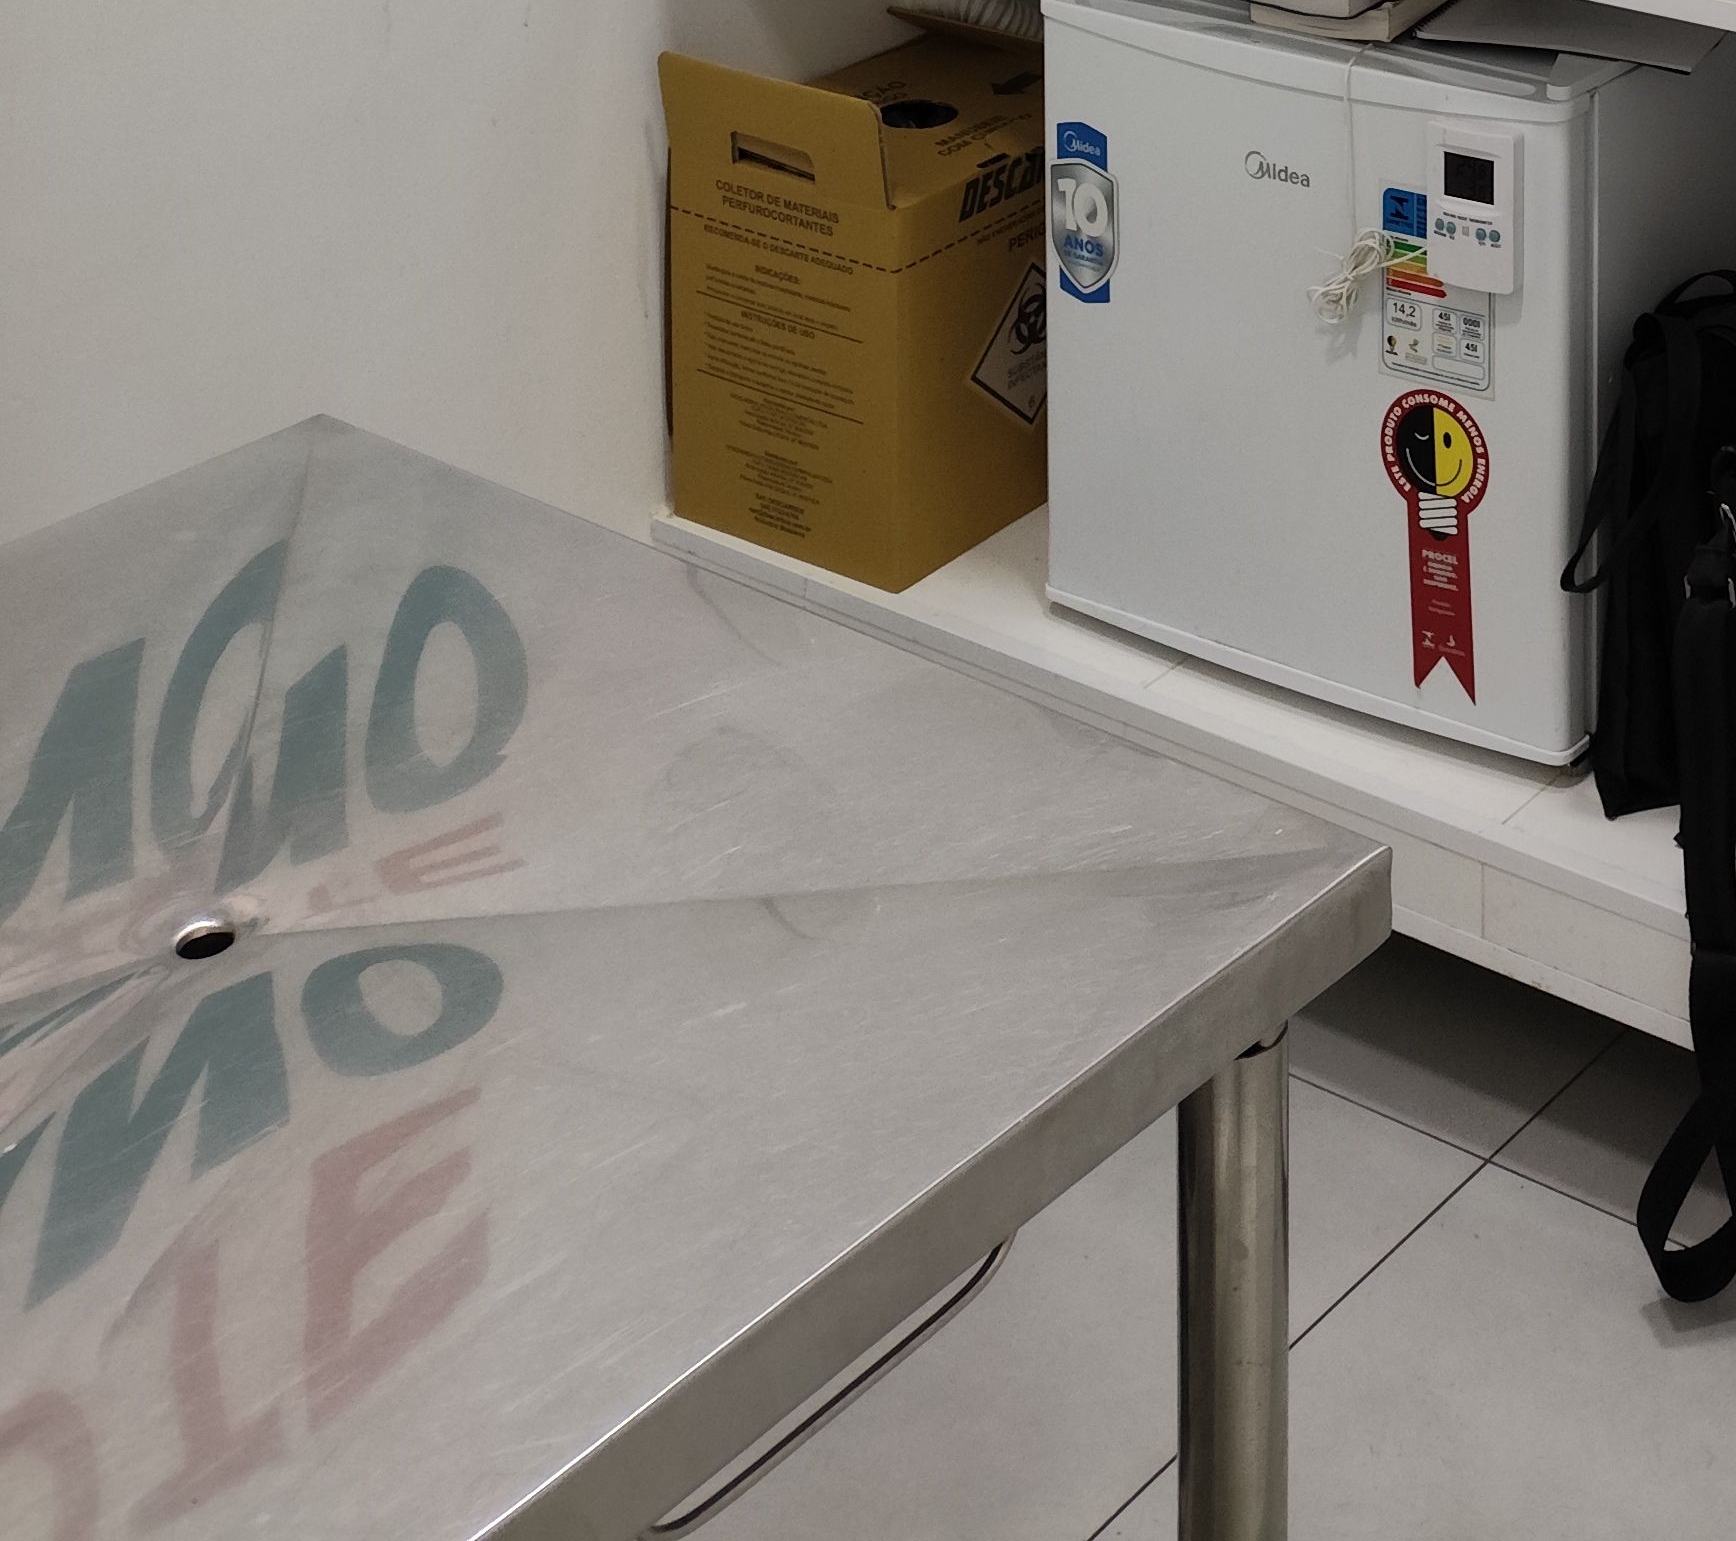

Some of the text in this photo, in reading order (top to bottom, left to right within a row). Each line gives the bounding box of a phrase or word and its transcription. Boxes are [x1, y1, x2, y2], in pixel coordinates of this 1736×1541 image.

[1063, 130, 1101, 157] Midea
[1244, 149, 1312, 189] Midea
[716, 179, 839, 224] COLETOR DE MATERIAIS
[1057, 177, 1108, 237] 10
[1064, 234, 1104, 258] ANOS
[1402, 393, 1455, 413] CONSOME
[1456, 410, 1485, 453] MENOS
[1422, 549, 1458, 564] PROCEL
